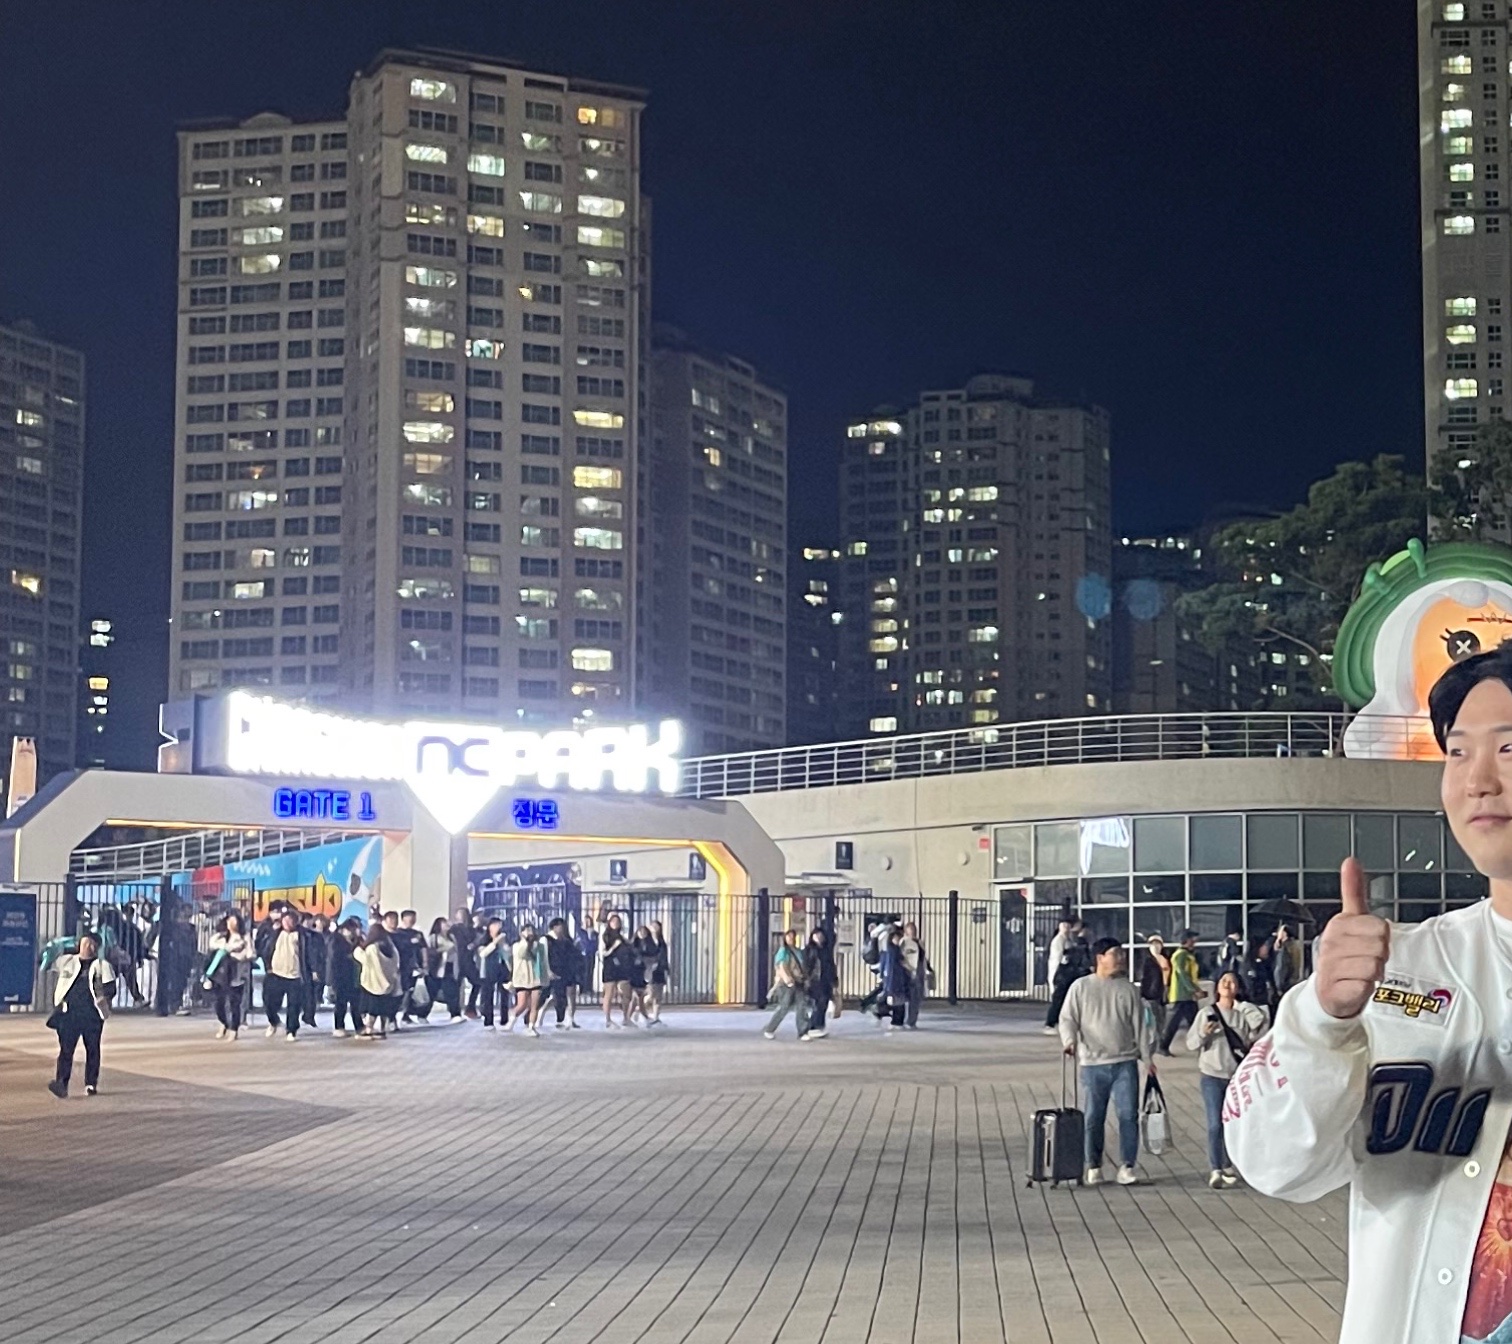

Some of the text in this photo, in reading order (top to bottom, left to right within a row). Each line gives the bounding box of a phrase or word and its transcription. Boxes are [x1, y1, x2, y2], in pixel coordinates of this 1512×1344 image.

[502, 719, 682, 793] PARK
[274, 788, 376, 820] GATE 1
[513, 799, 558, 829] 정문
